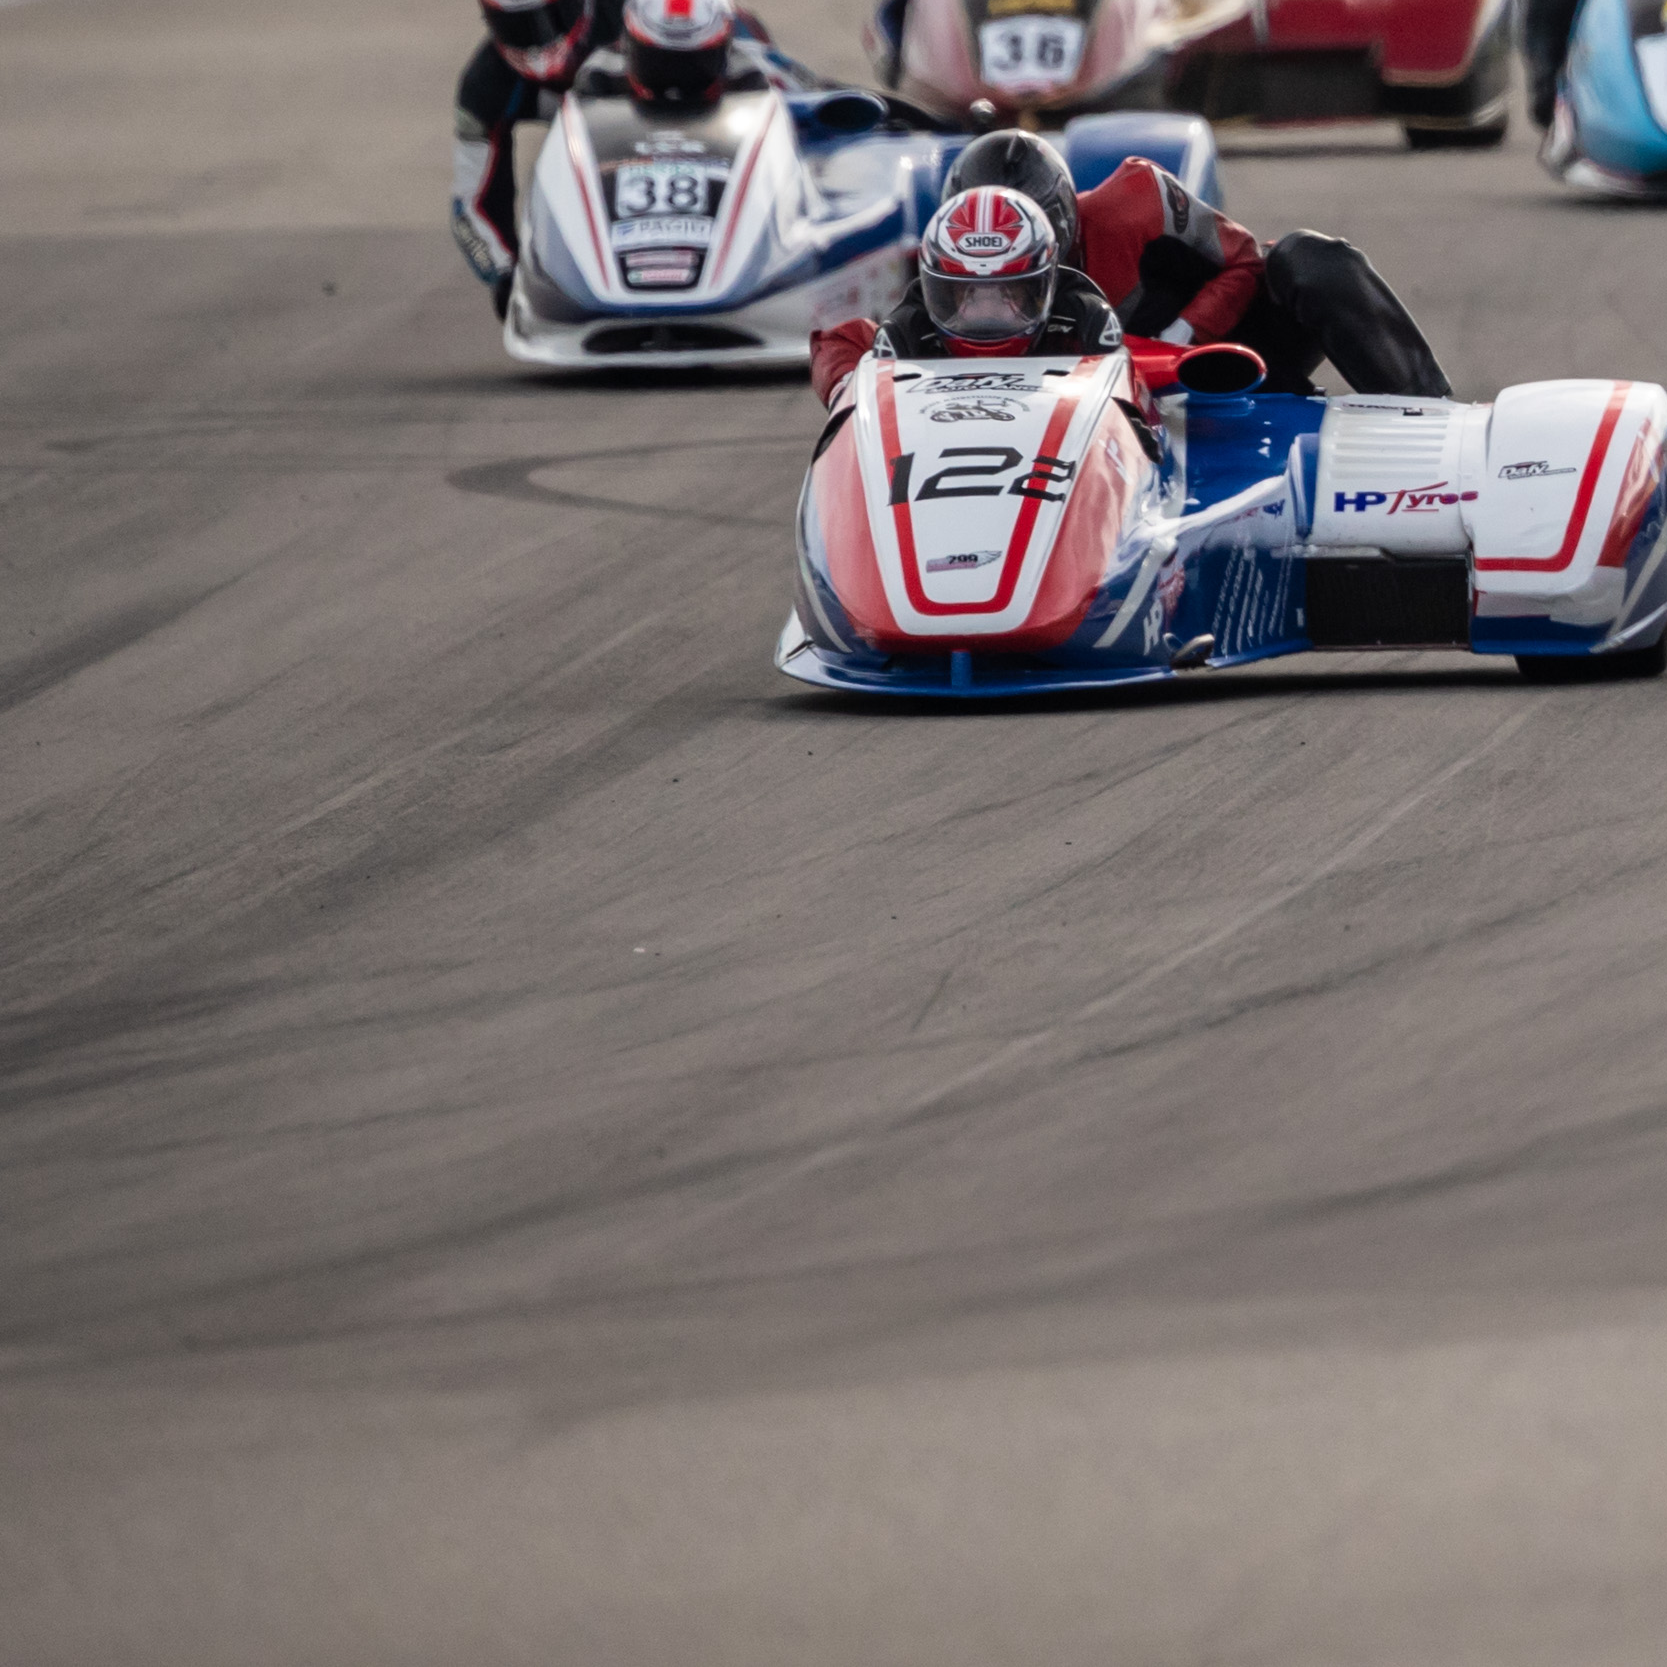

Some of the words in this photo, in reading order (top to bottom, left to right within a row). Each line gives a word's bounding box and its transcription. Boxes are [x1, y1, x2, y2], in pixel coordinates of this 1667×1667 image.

[624, 174, 699, 213] 38
[964, 236, 1003, 248] SHOEI
[1334, 491, 1387, 513] HP
[1385, 480, 1479, 515] Tyres
